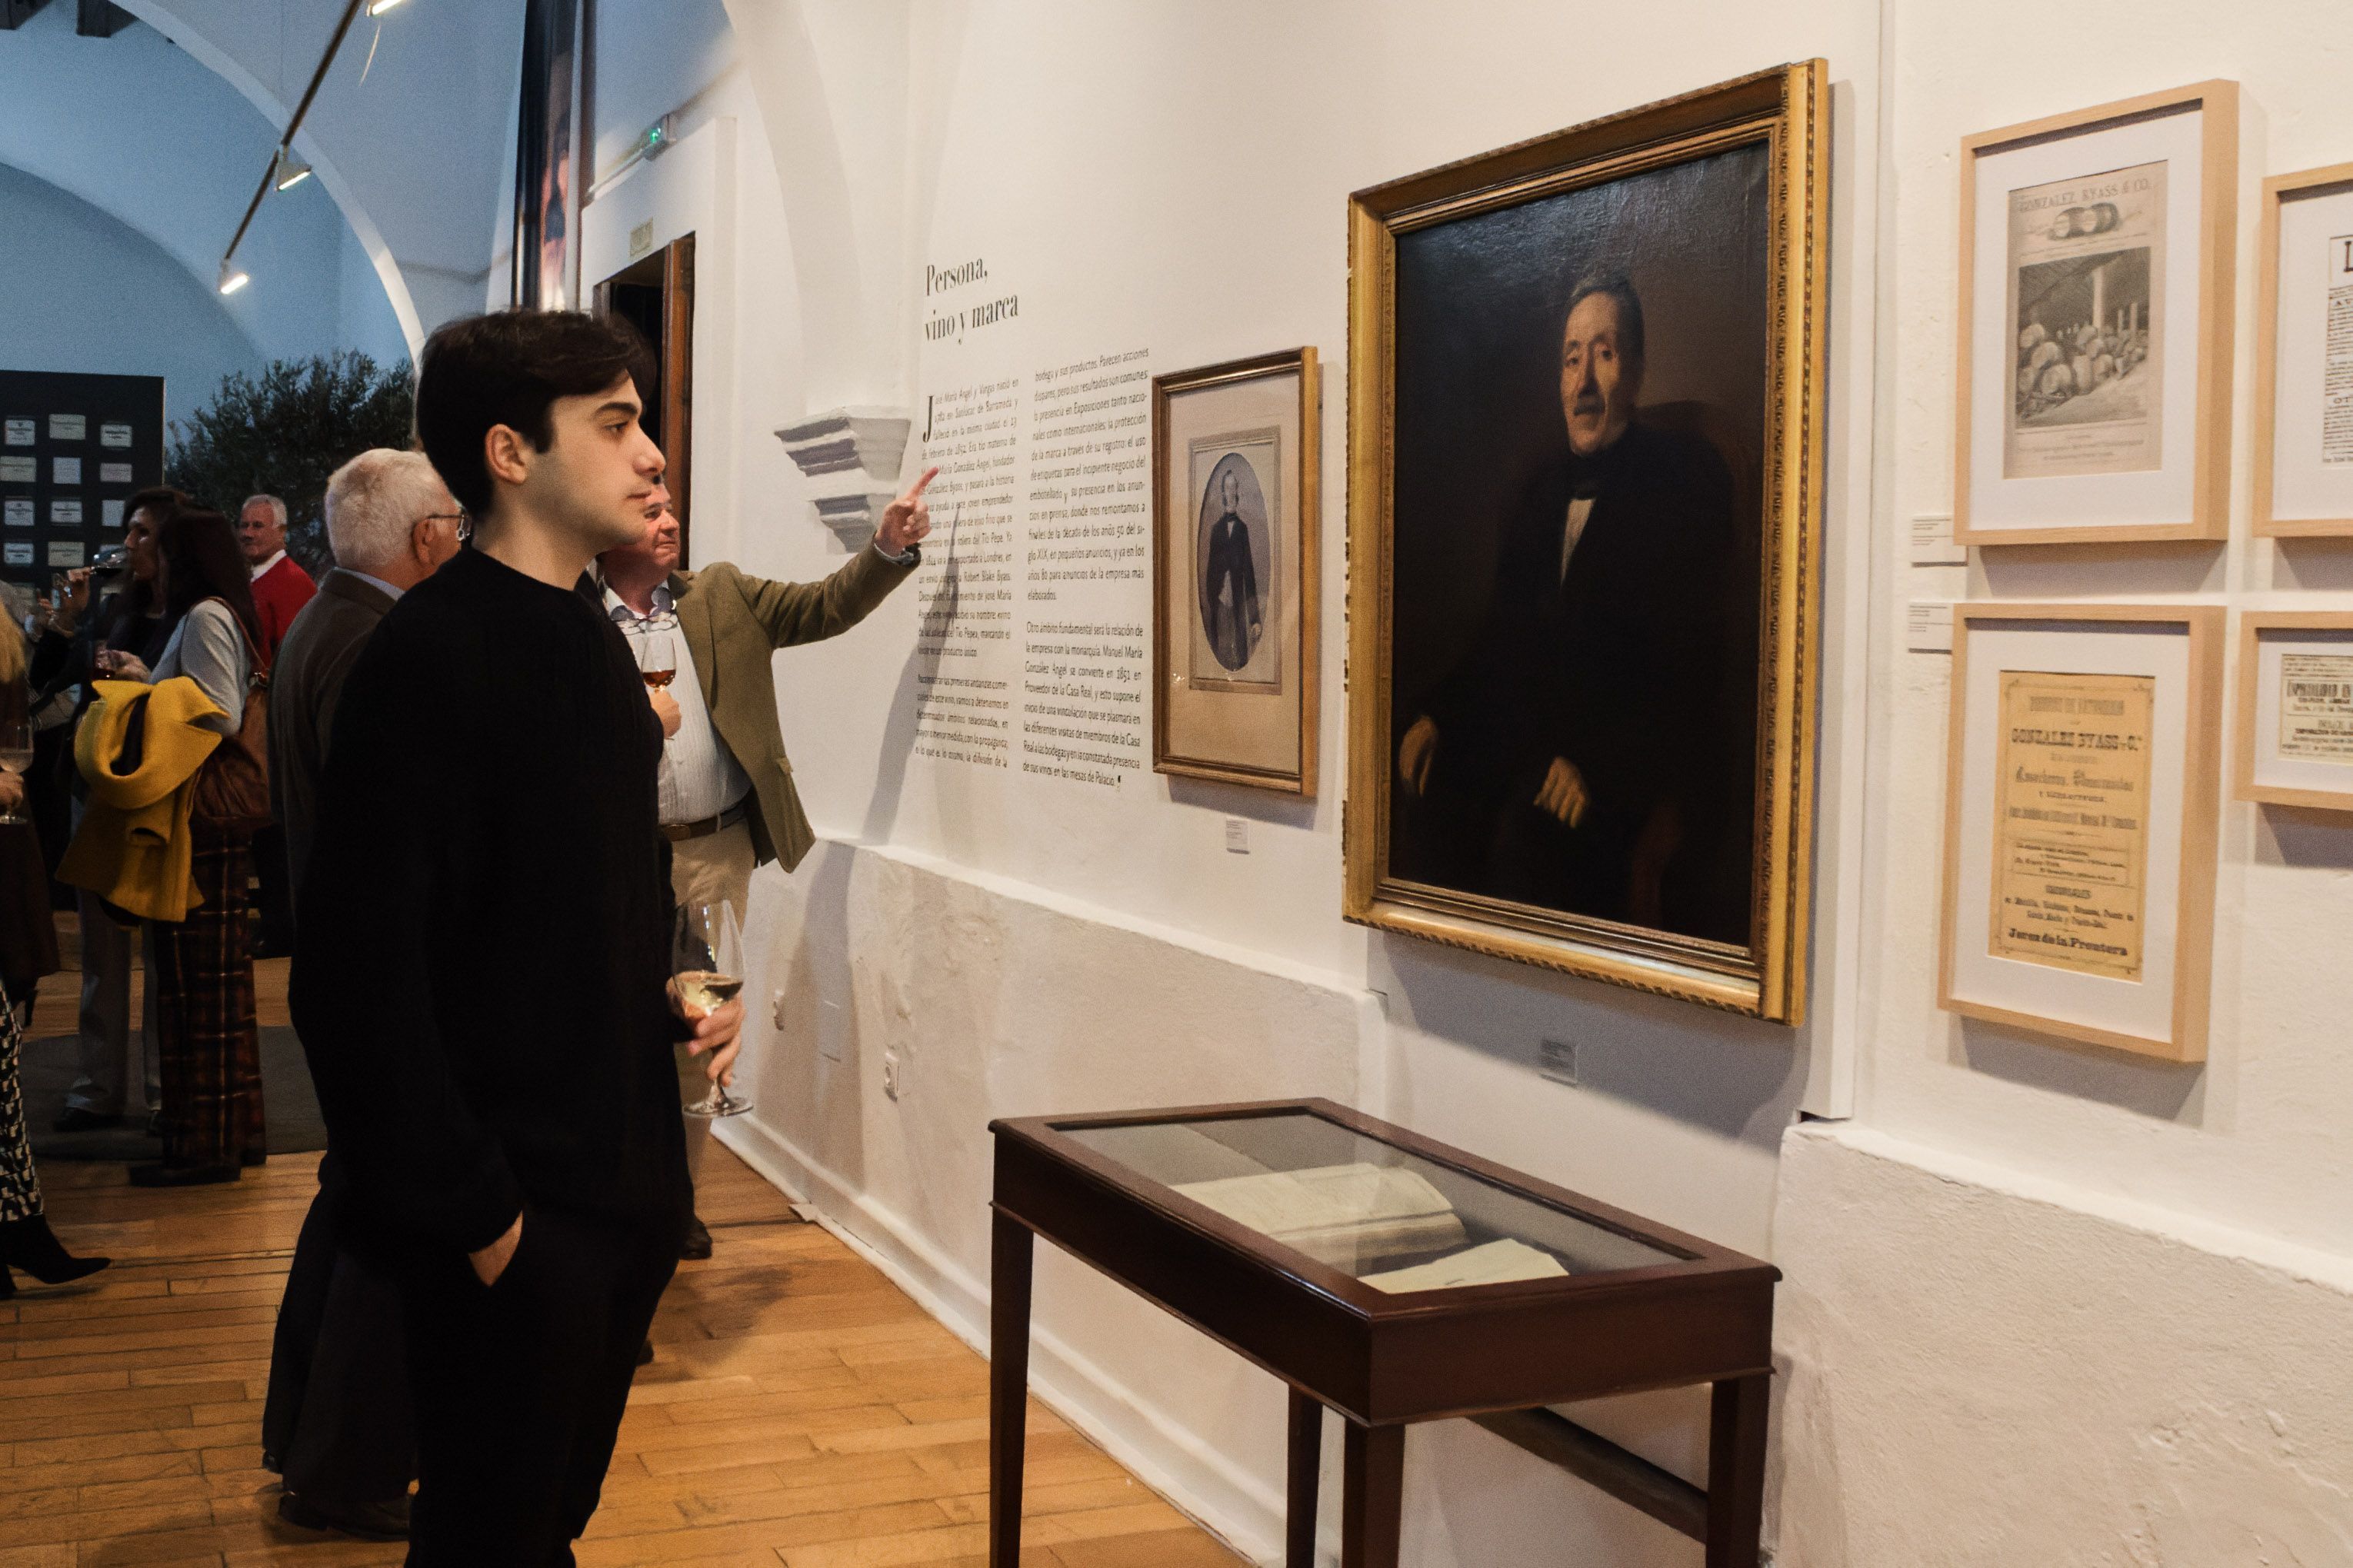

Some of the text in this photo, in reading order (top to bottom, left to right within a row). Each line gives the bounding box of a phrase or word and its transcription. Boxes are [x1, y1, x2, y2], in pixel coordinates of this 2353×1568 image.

[926, 258, 988, 296] Persona,
[925, 295, 1019, 345] vino y marca
